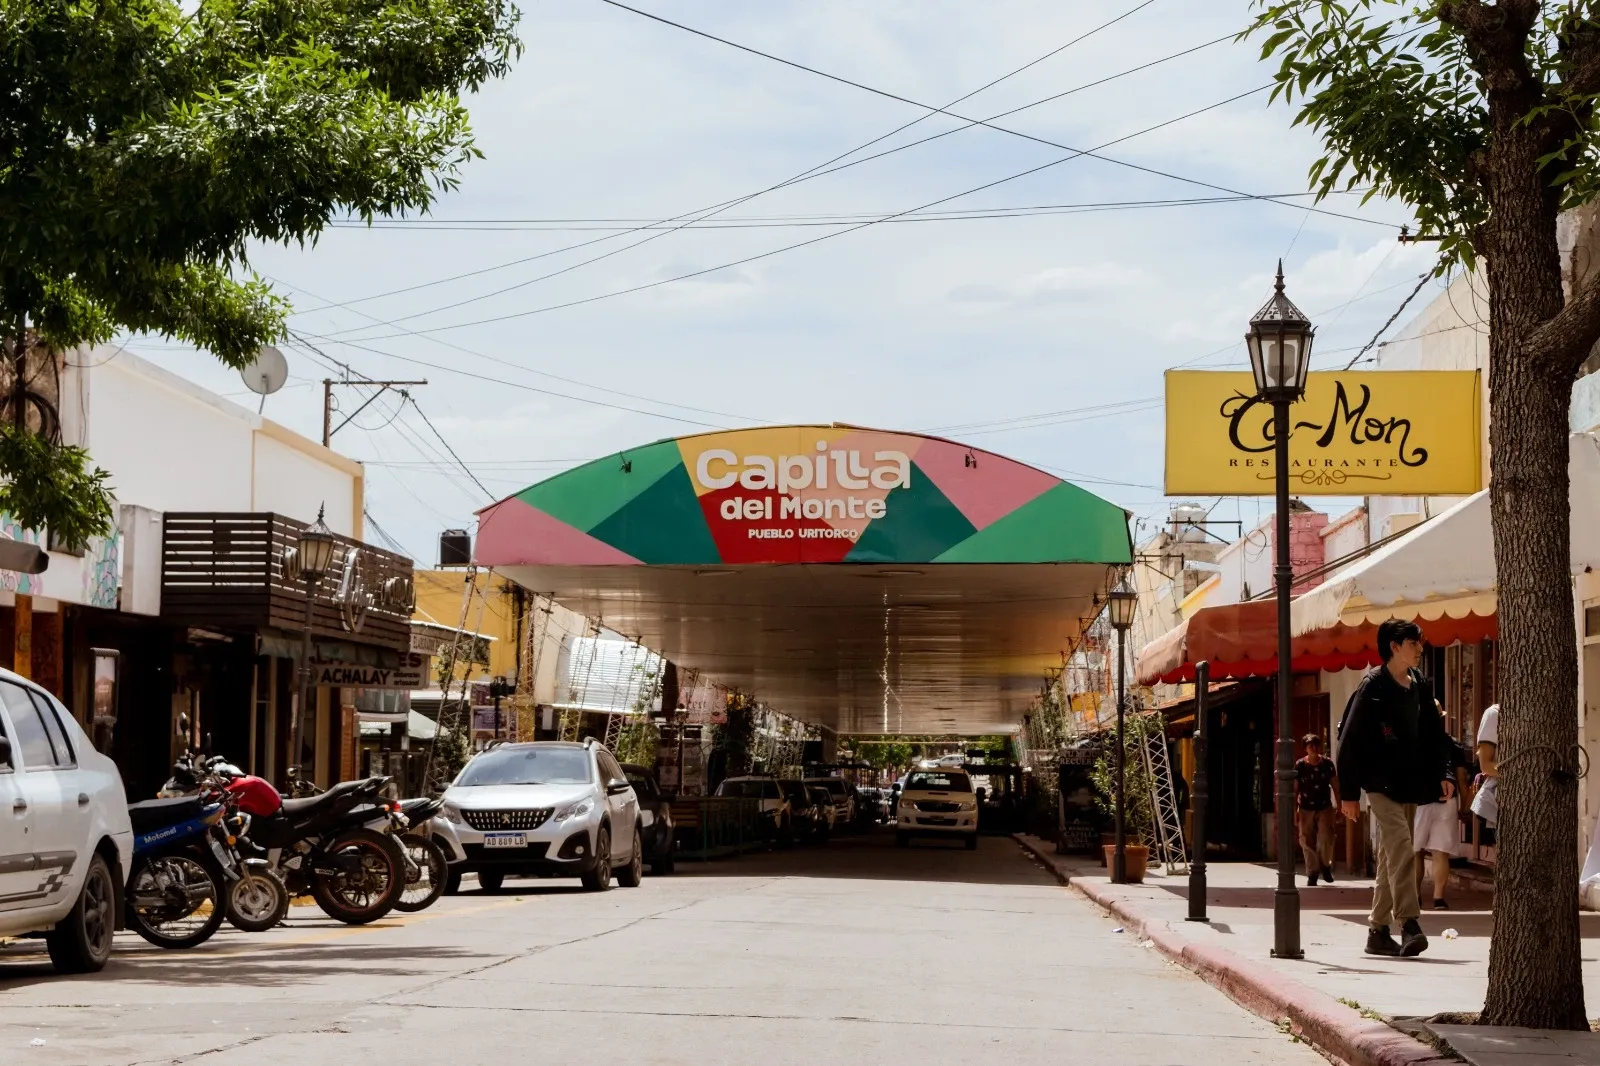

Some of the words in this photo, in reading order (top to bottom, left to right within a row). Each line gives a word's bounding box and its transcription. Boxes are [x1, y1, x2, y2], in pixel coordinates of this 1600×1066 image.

[696, 440, 911, 494] Capilla
[1229, 458, 1398, 467] RESAURANTE
[720, 496, 773, 520] del
[780, 496, 887, 520] Monte
[748, 528, 794, 540] PUEBLO
[799, 528, 859, 539] URITORCO
[321, 668, 391, 685] ACHALAY
[143, 826, 177, 844] Motomel
[487, 837, 497, 846] AD
